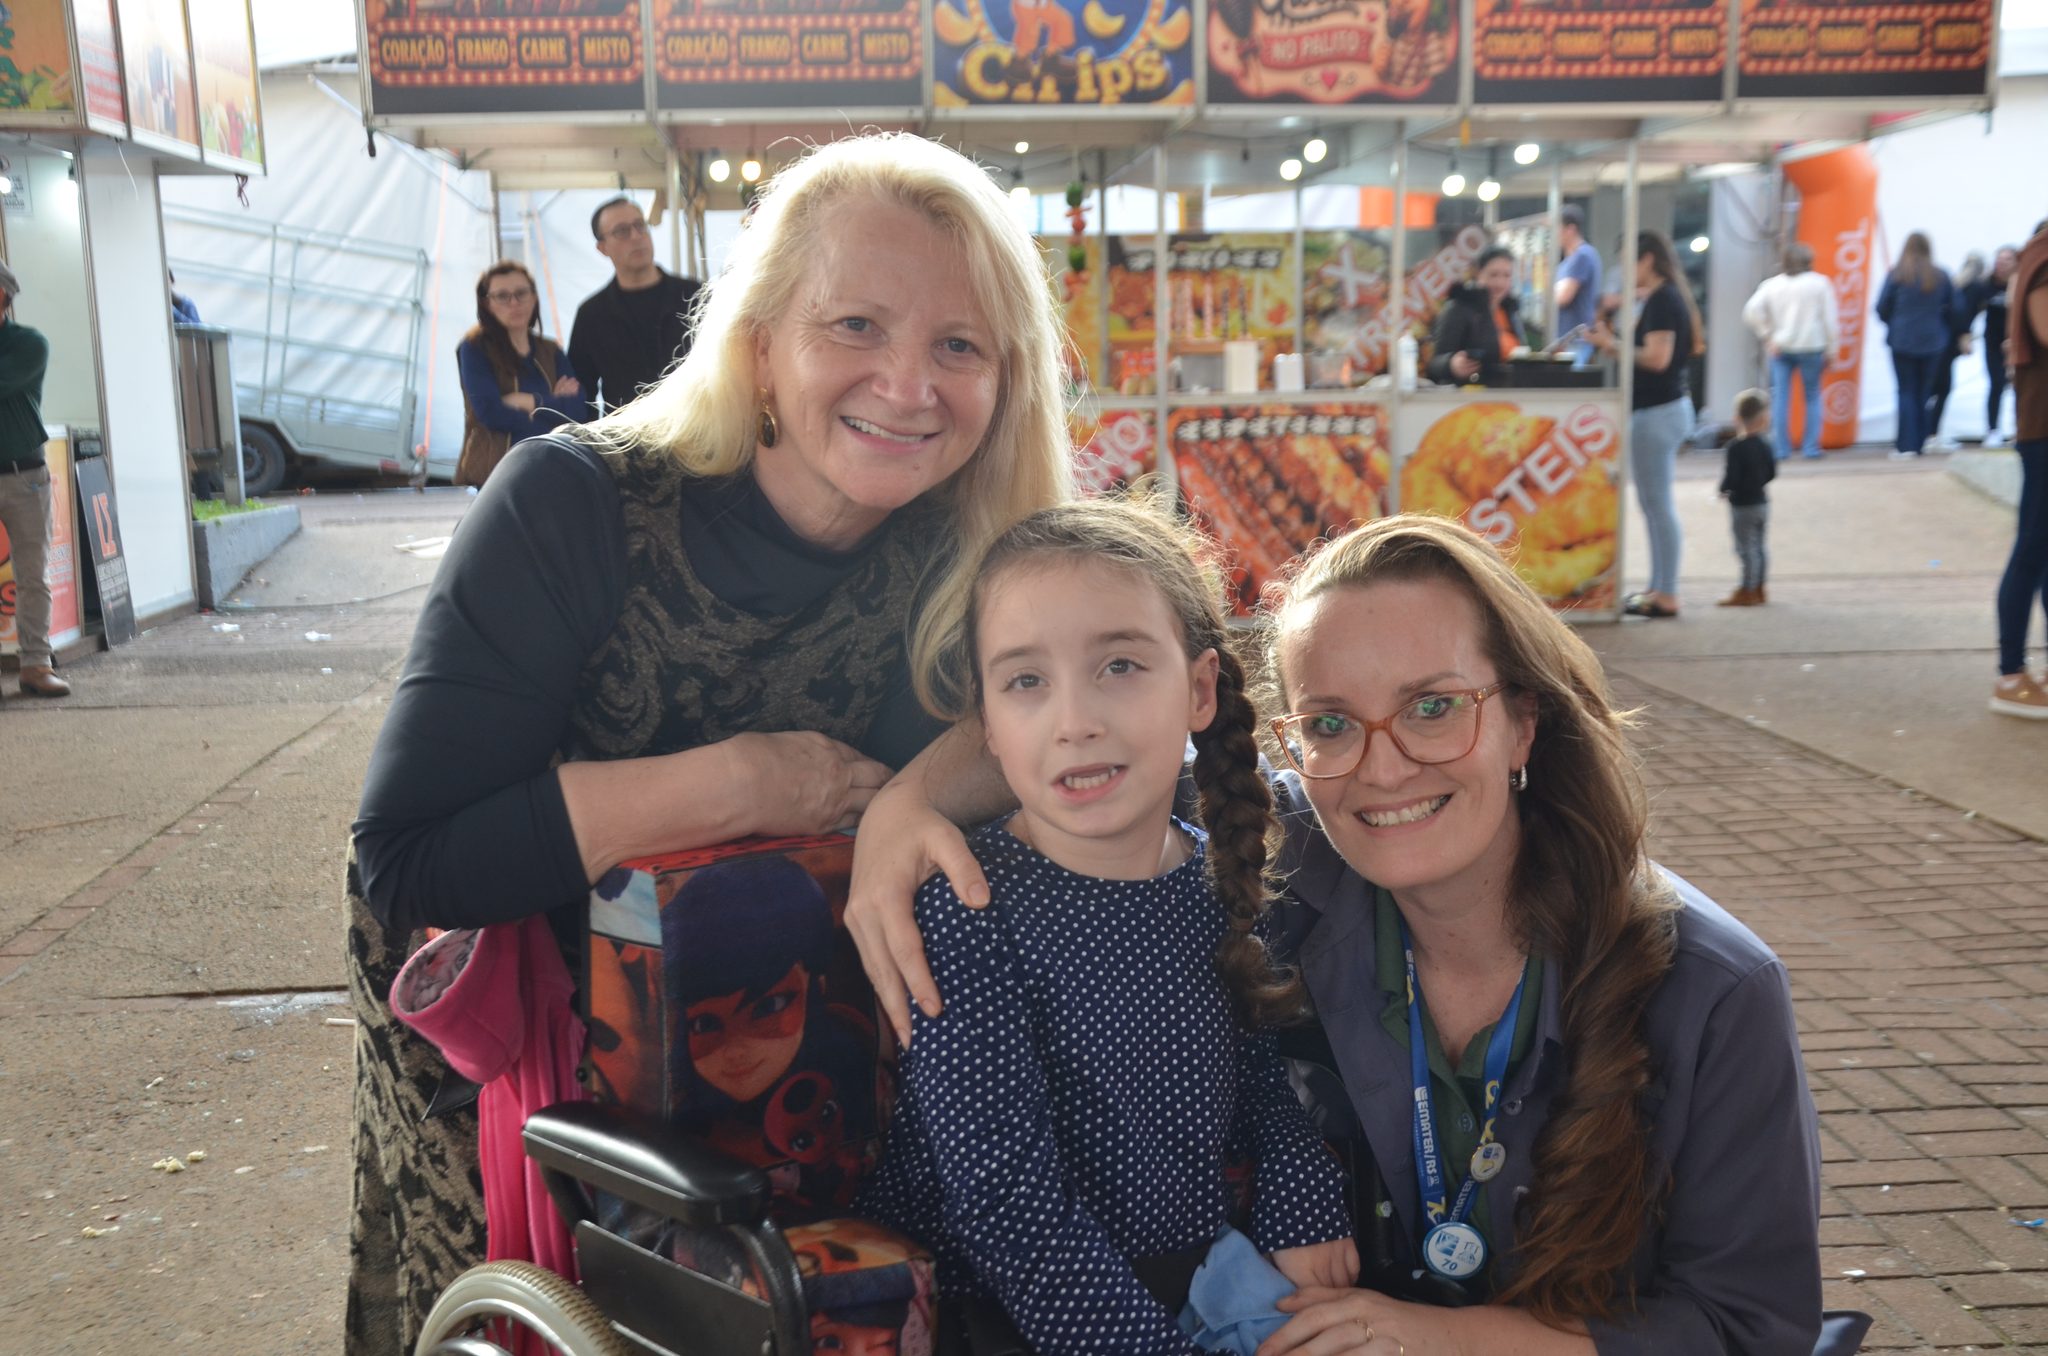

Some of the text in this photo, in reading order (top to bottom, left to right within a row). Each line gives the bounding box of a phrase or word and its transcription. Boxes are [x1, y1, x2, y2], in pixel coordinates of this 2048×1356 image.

[382, 35, 631, 69] CORAÇÃO FRANGO CARNE MISTO
[1831, 218, 1870, 372] CRESOL
[1468, 404, 1615, 544] STEIS
[1417, 1100, 1438, 1176] EMATER/RS
[1442, 1258, 1458, 1271] 70
